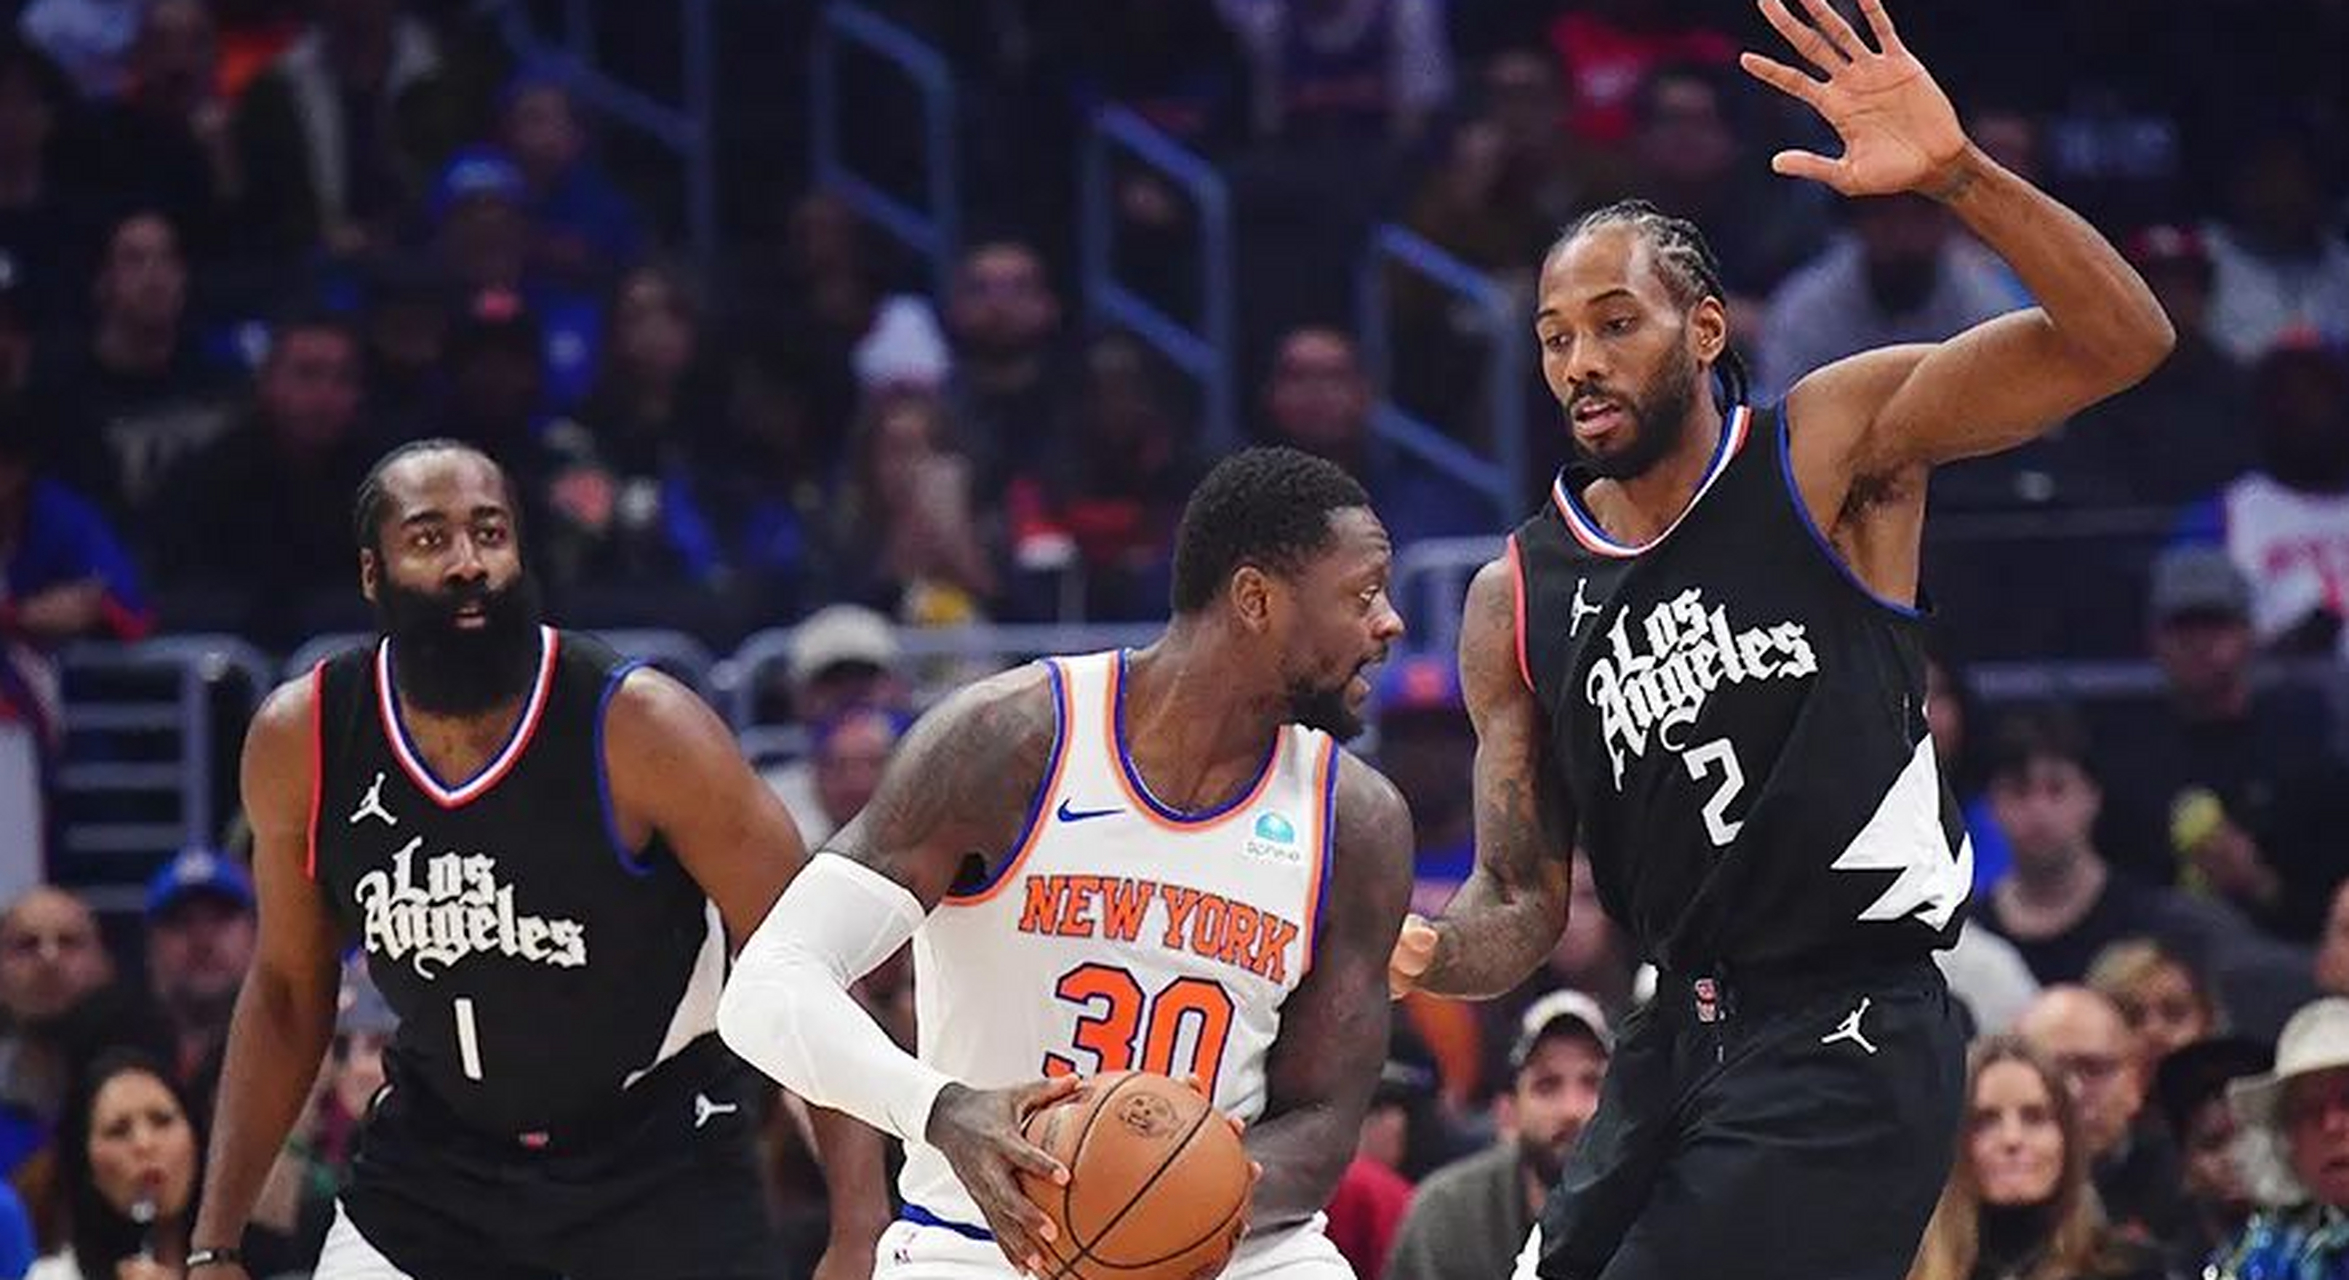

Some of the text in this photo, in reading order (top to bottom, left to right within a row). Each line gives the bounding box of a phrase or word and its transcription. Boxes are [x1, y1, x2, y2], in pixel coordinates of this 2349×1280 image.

[1607, 588, 1709, 684] Los
[1586, 603, 1819, 791] Angeles
[1683, 738, 1744, 846] 2
[355, 869, 587, 980] Angeles
[391, 836, 496, 905] Los
[1019, 875, 1299, 984] NEW YORK
[454, 998, 483, 1080] 1
[1042, 961, 1235, 1101] 30
